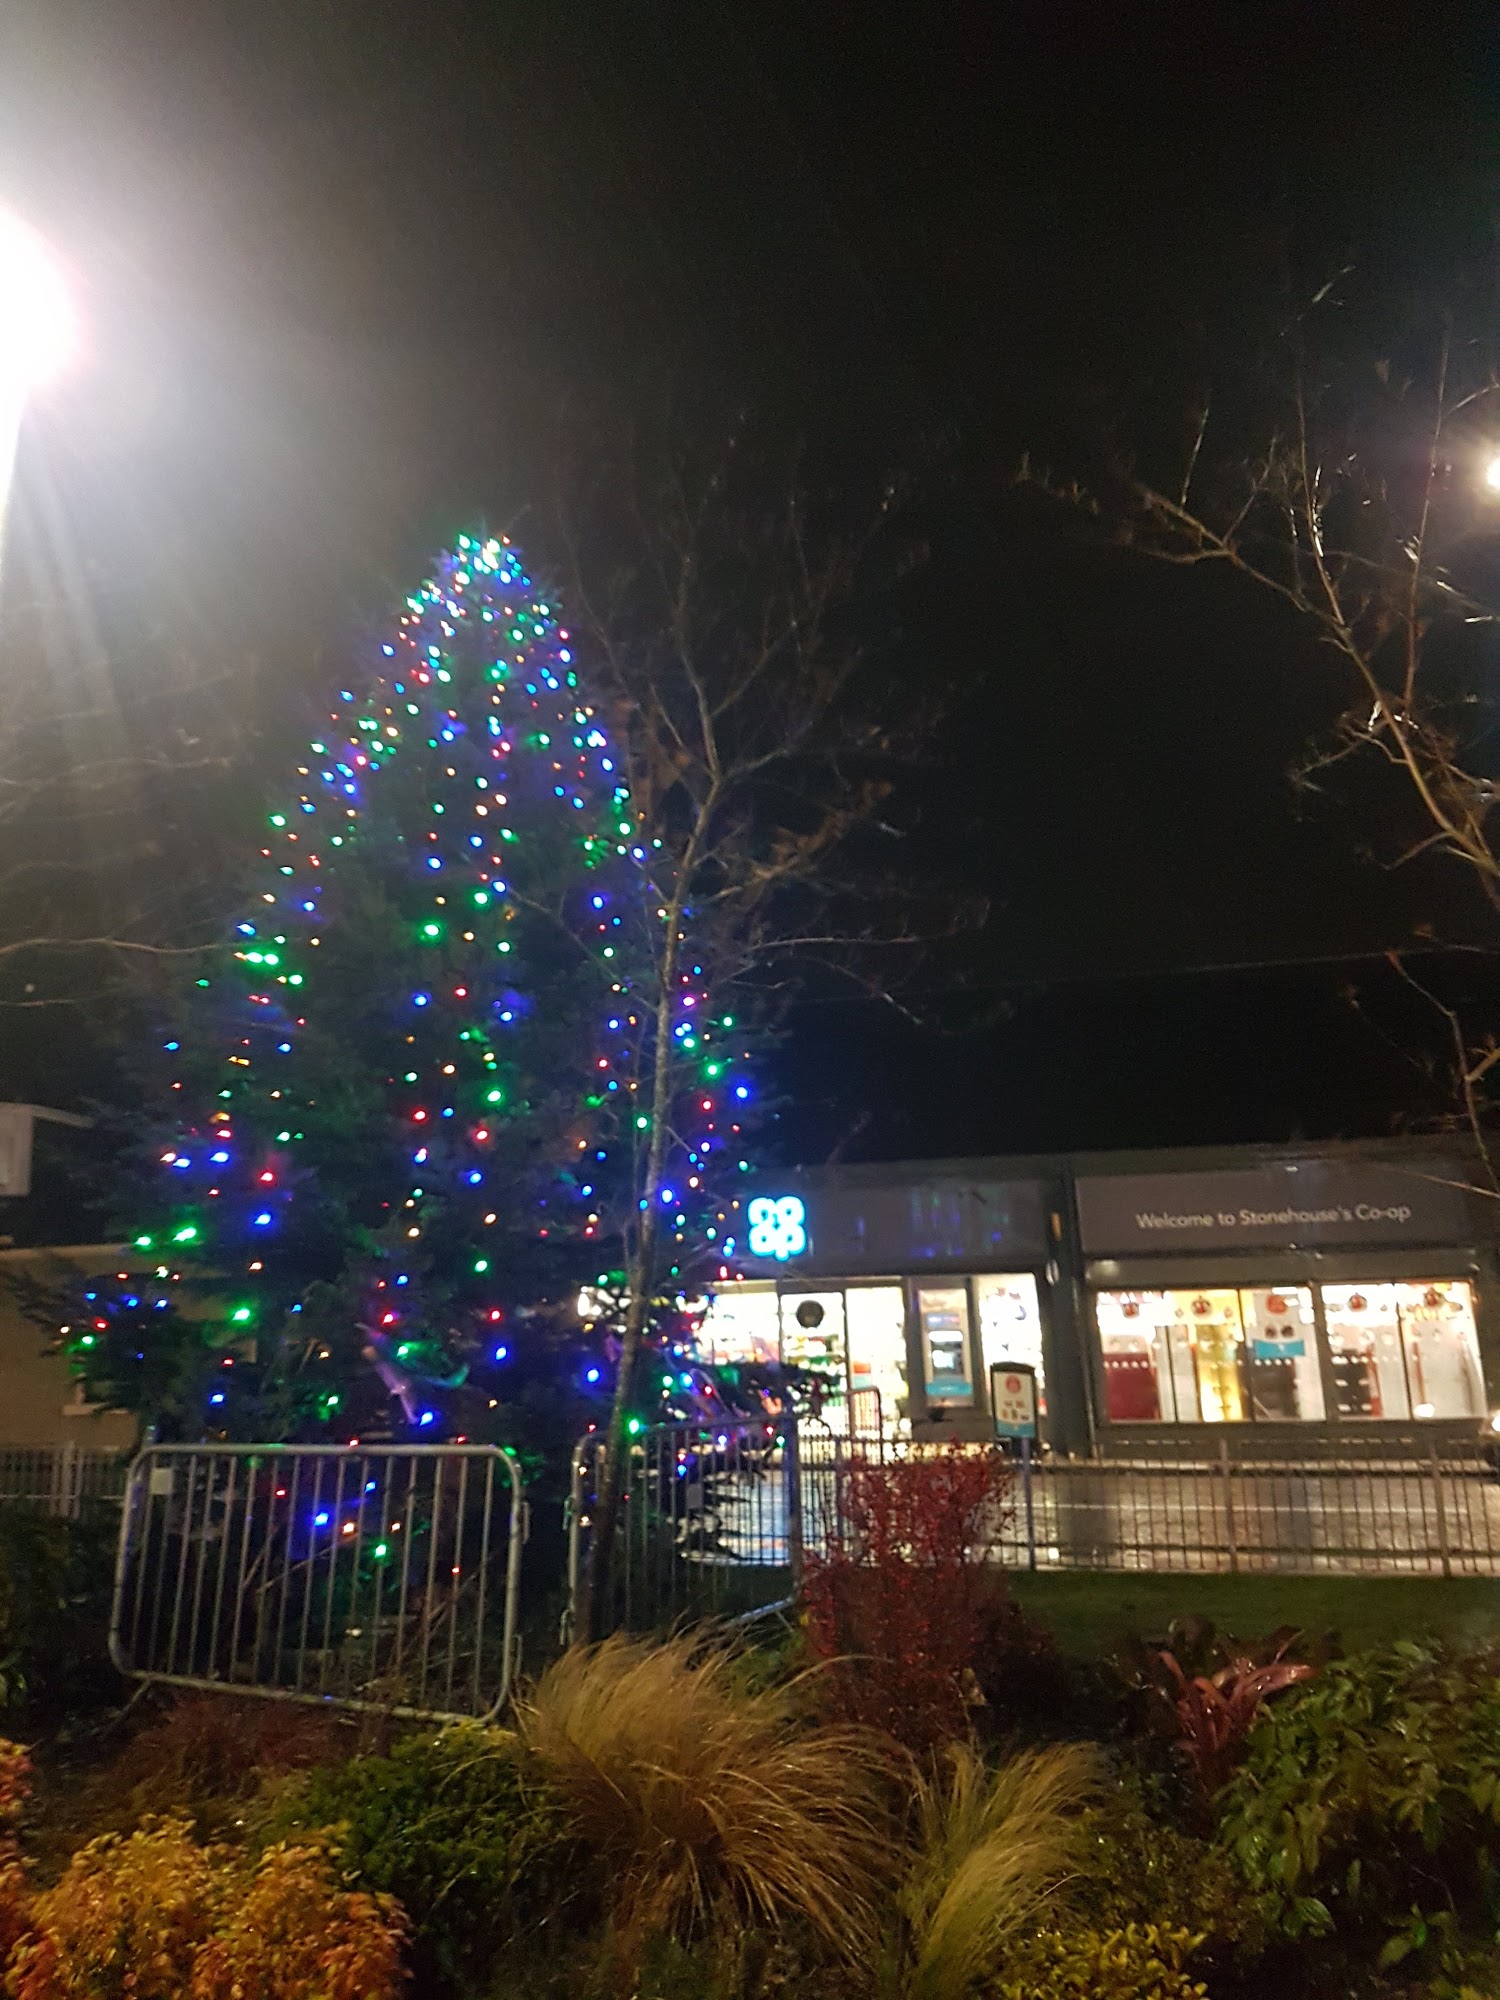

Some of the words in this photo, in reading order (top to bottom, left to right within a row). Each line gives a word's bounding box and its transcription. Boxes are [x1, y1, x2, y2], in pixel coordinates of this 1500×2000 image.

[1135, 1211, 1214, 1229] Welcome
[1217, 1211, 1236, 1227] to
[1239, 1204, 1353, 1227] Stonehouse's
[1354, 1203, 1411, 1224] Co-op
